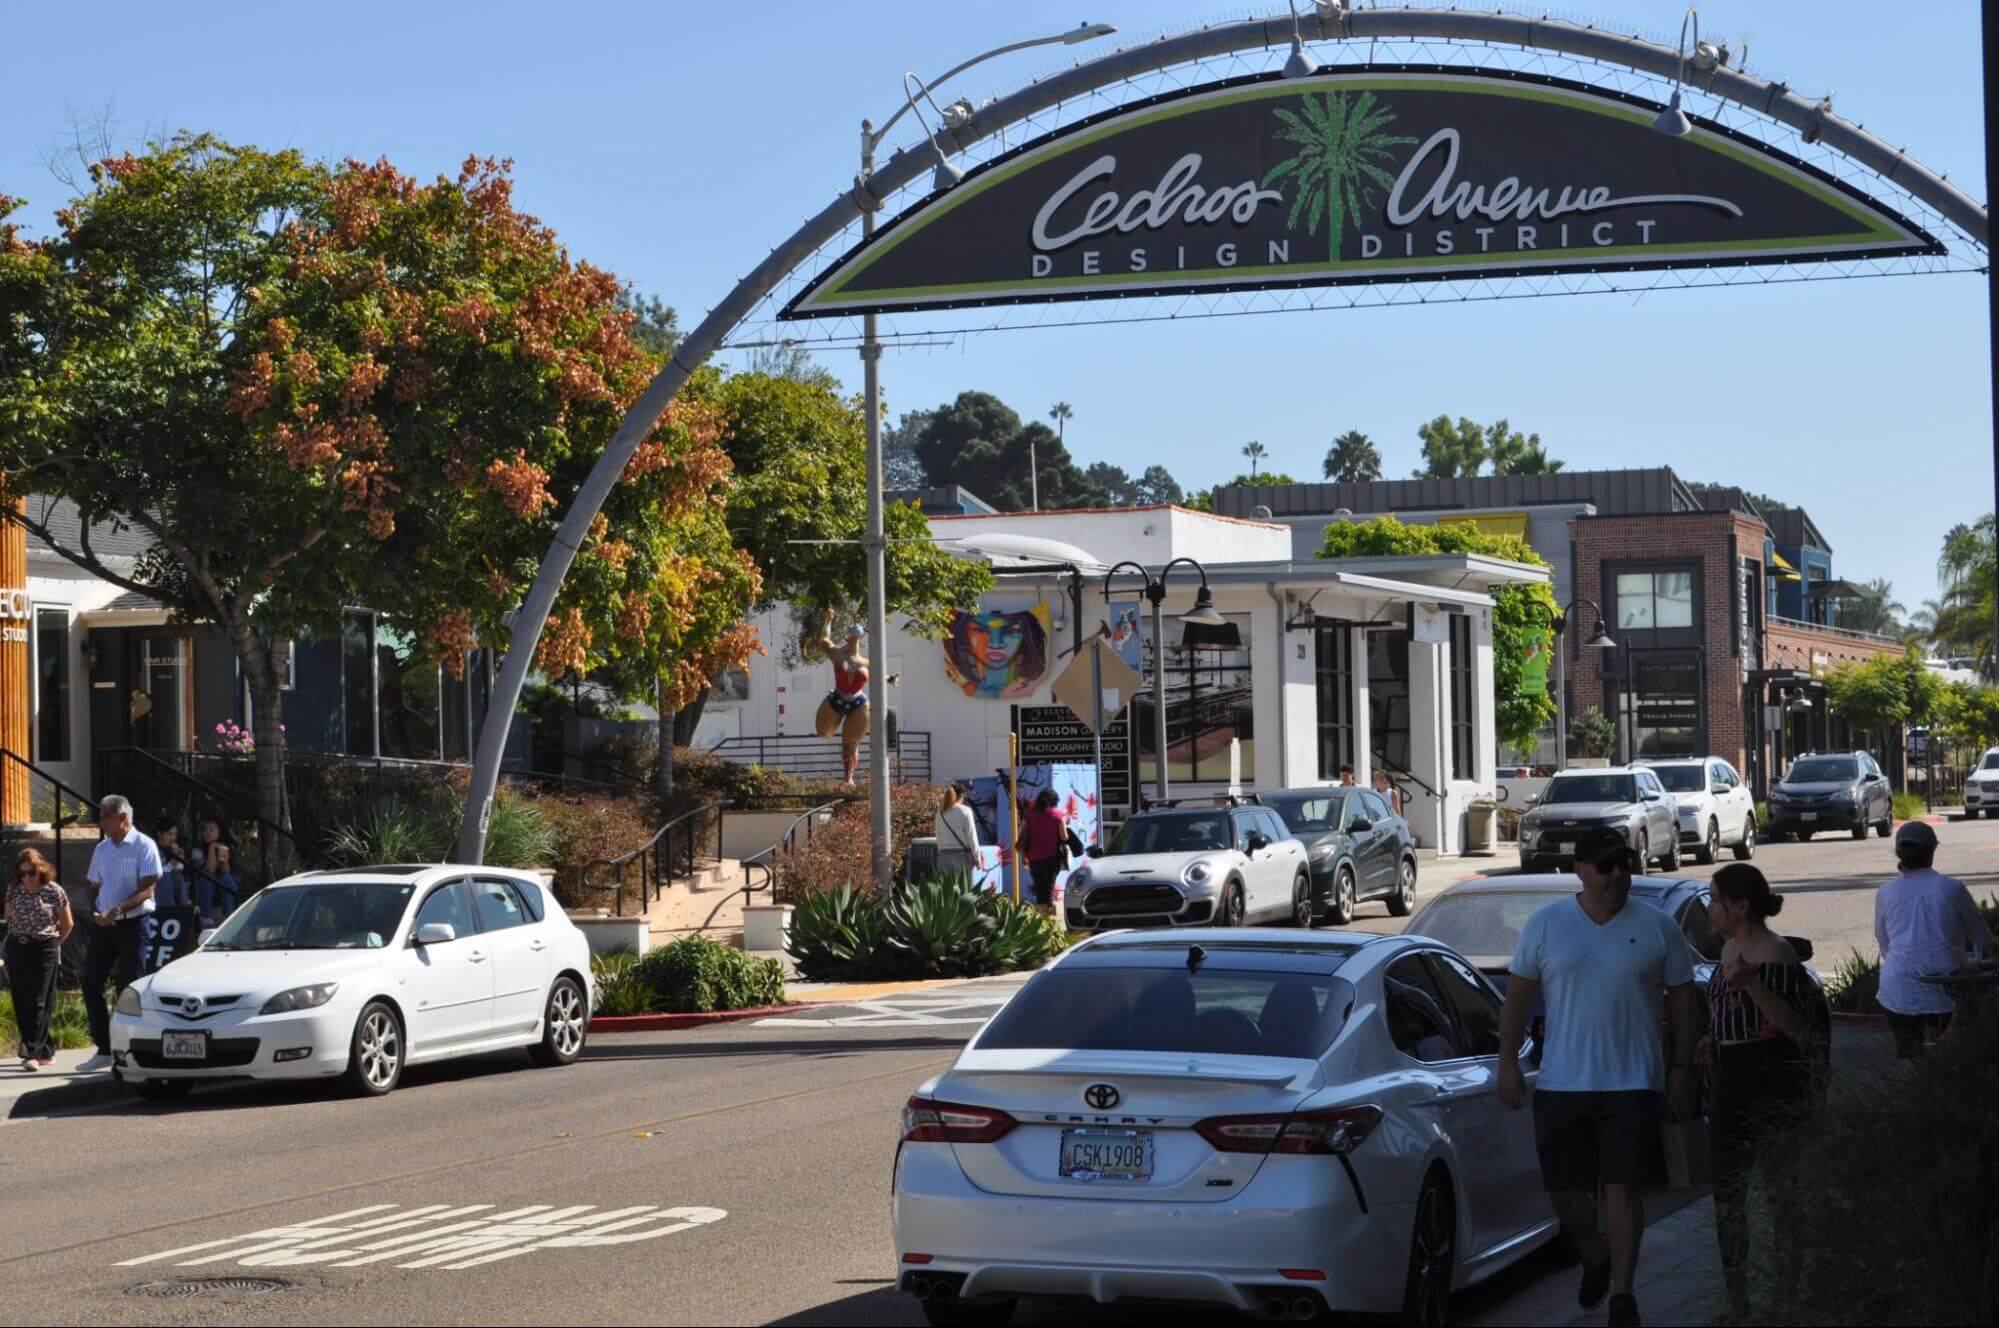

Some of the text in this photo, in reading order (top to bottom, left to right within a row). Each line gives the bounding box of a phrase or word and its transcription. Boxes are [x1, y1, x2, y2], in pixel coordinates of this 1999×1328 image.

[1032, 127, 1744, 252] Cedros Avenue
[1031, 219, 1657, 278] DESIGN DISTRICT
[1026, 725, 1123, 737] MADISON GERY
[1026, 742, 1124, 754] PHOTOGRAPHY SUDIO
[1044, 1114, 1164, 1124] CAMRY
[1072, 1144, 1143, 1167] CSK1908
